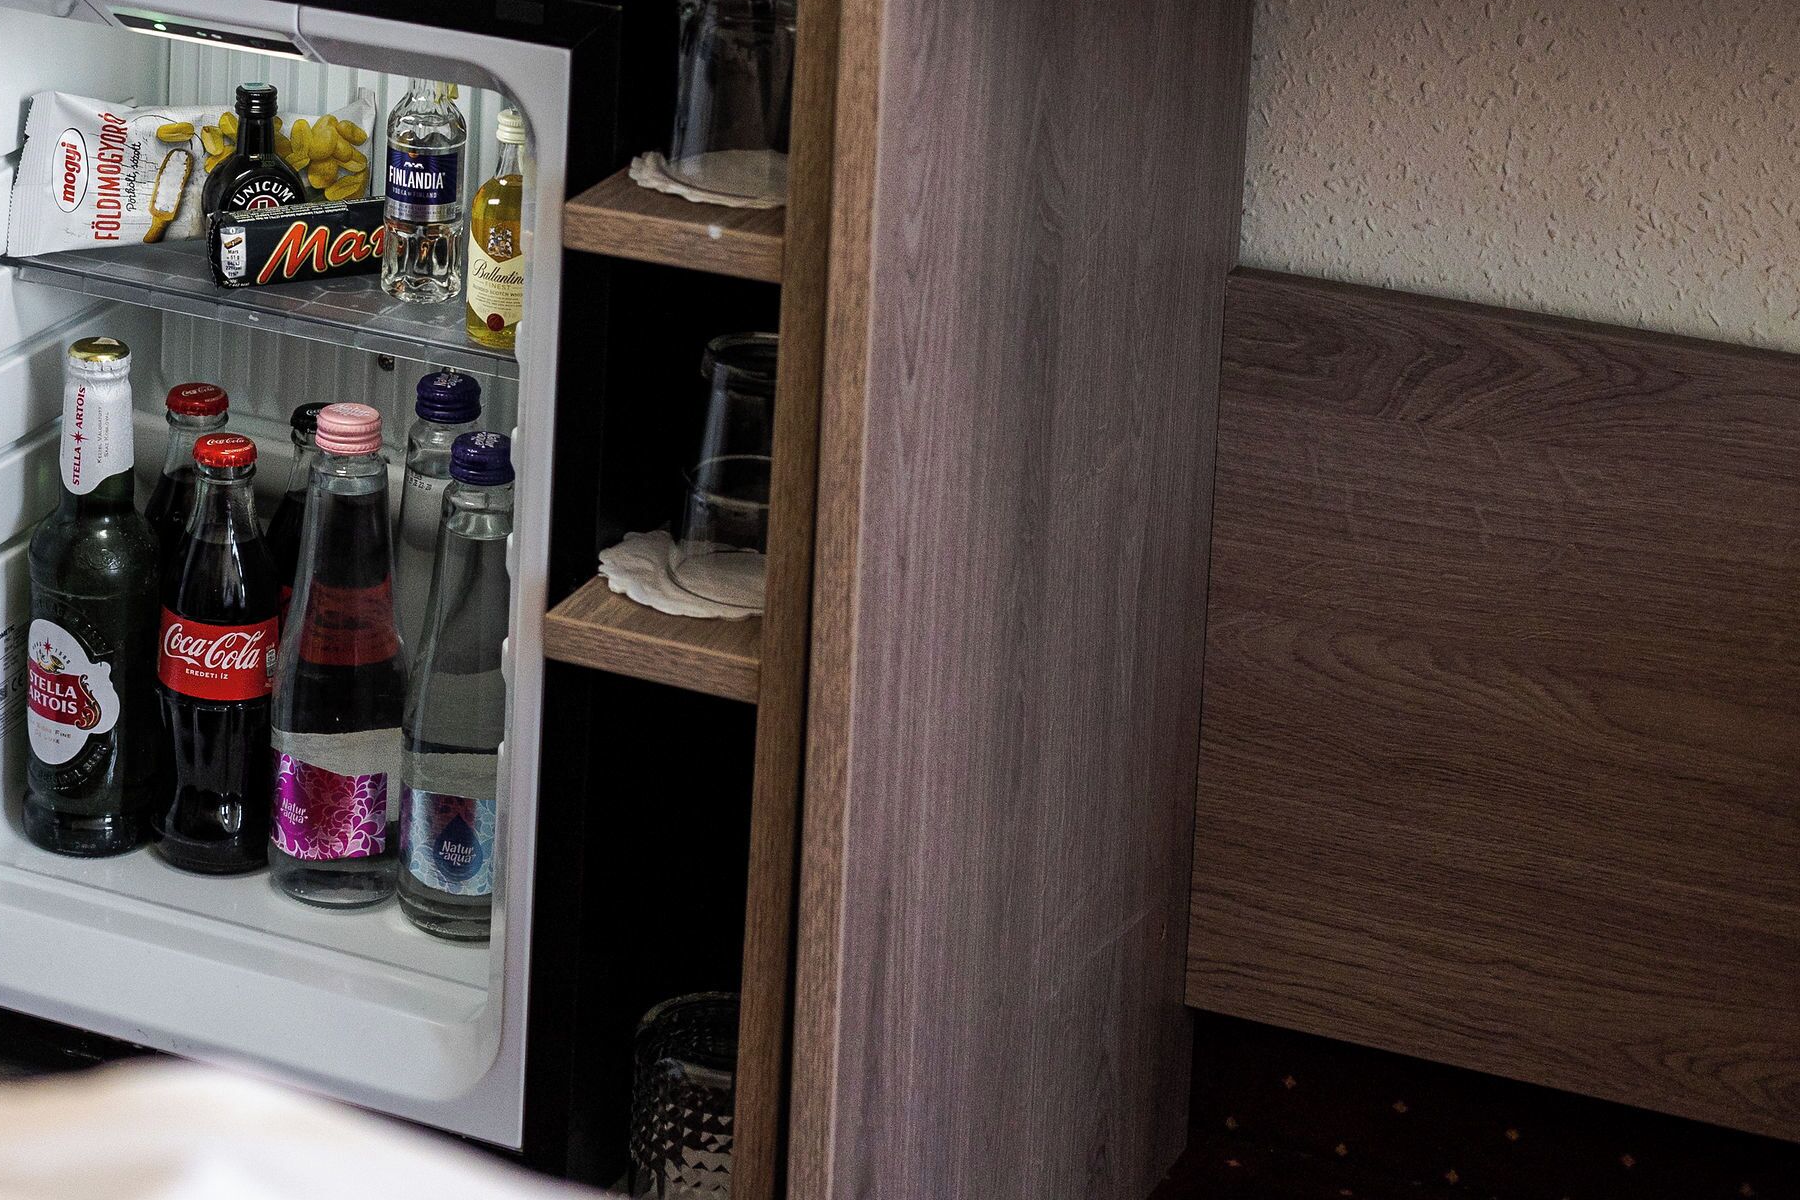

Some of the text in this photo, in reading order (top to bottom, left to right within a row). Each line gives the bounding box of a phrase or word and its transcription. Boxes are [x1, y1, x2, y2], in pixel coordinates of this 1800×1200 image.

[61, 141, 82, 204] mogyi
[91, 112, 129, 241] FÖLDIMOGYORÓ
[388, 165, 445, 190] FINLANDIA
[233, 181, 294, 207] UNICUM
[256, 220, 385, 285] Mar
[72, 386, 86, 486] STELLA ARTOIS
[163, 622, 266, 670] Coca-Cola
[29, 669, 78, 700] STELLA
[185, 668, 218, 679] EREDETI
[28, 685, 78, 715] ARTOIS
[281, 797, 307, 816] Natur
[282, 809, 306, 825] aqua
[441, 840, 474, 855] Natur
[442, 850, 474, 866] aqua
